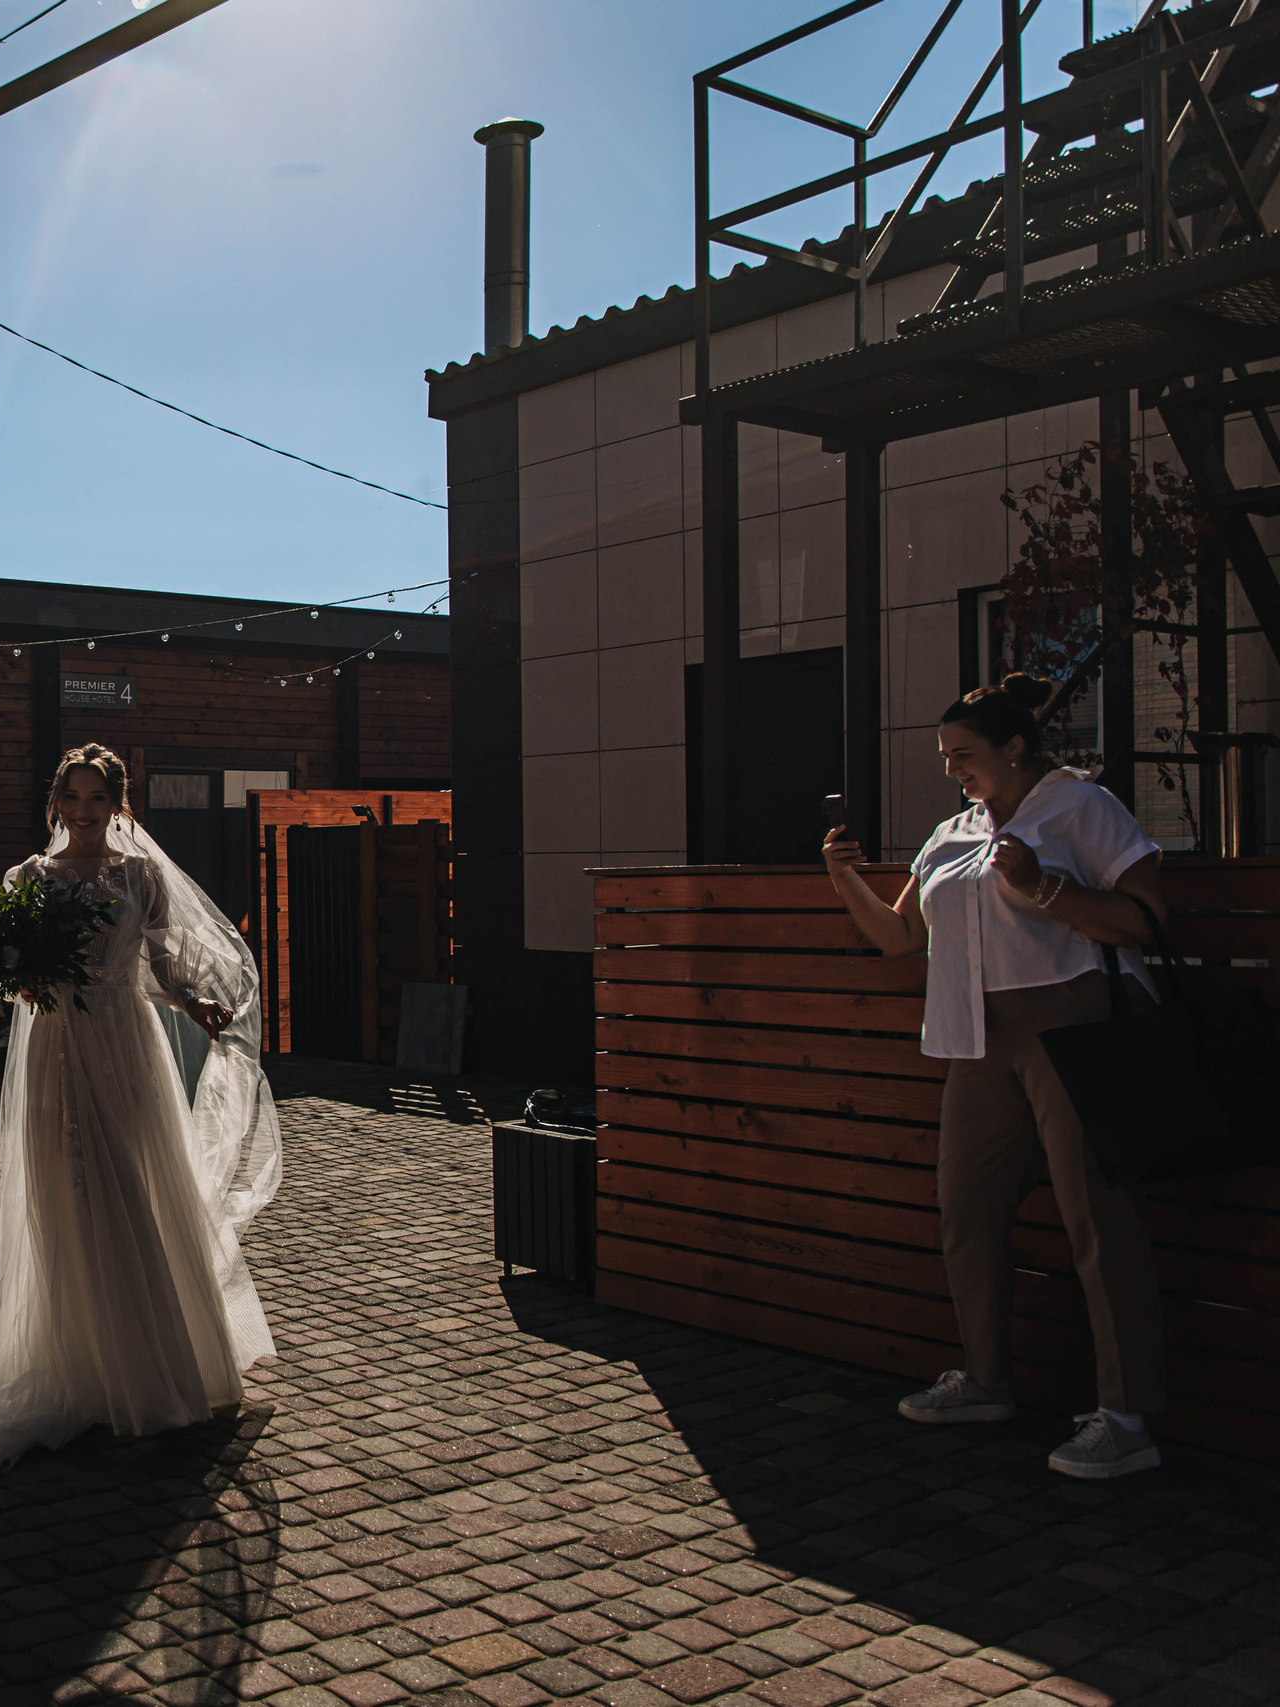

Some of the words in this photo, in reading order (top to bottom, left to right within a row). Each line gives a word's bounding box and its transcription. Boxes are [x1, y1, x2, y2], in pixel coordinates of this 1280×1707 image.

[64, 680, 116, 691] PREMIER
[64, 694, 90, 703] HOUSE
[92, 695, 116, 704] HOTEL
[120, 683, 133, 704] 4
